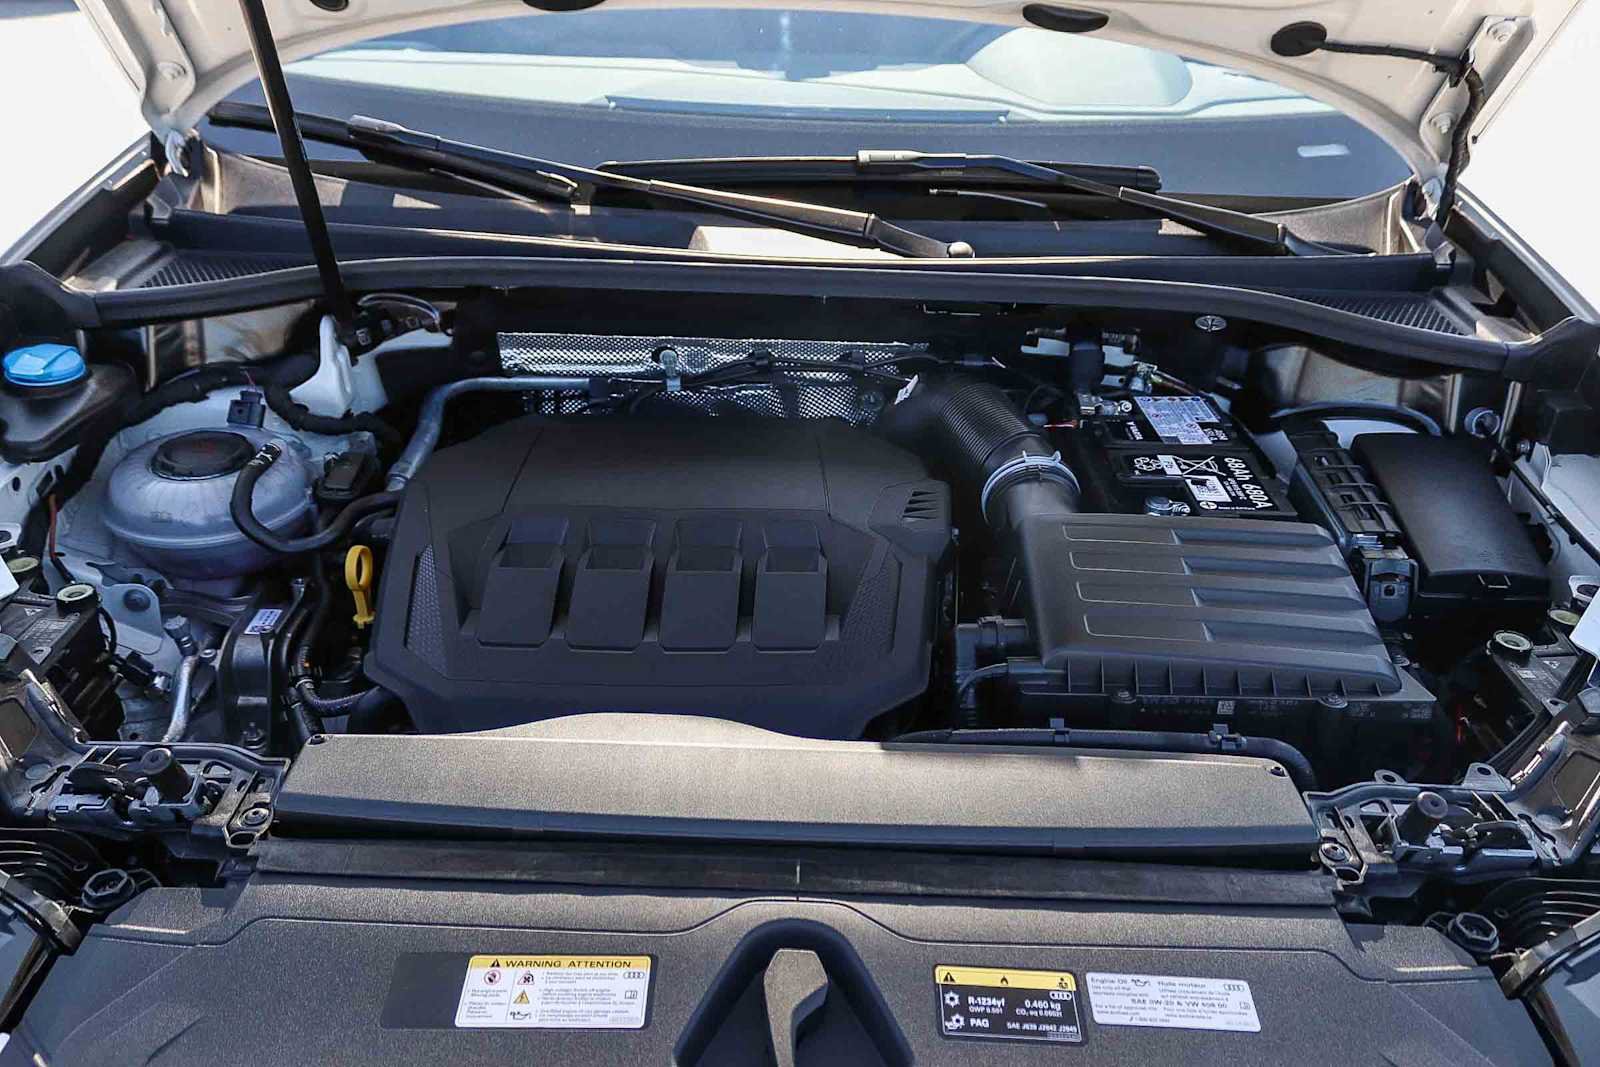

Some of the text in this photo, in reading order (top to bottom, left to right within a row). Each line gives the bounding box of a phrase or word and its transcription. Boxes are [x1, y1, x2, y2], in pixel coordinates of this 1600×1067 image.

[1224, 457, 1253, 480] 68Ah
[1241, 484, 1273, 508] 680A
[505, 960, 561, 968] WARNING
[1091, 977, 1116, 985] Engine
[968, 996, 1005, 1008] R-1234yf
[1050, 1002, 1061, 1011] kg
[970, 1018, 989, 1028] PAG
[1007, 1021, 1020, 1030] SAE
